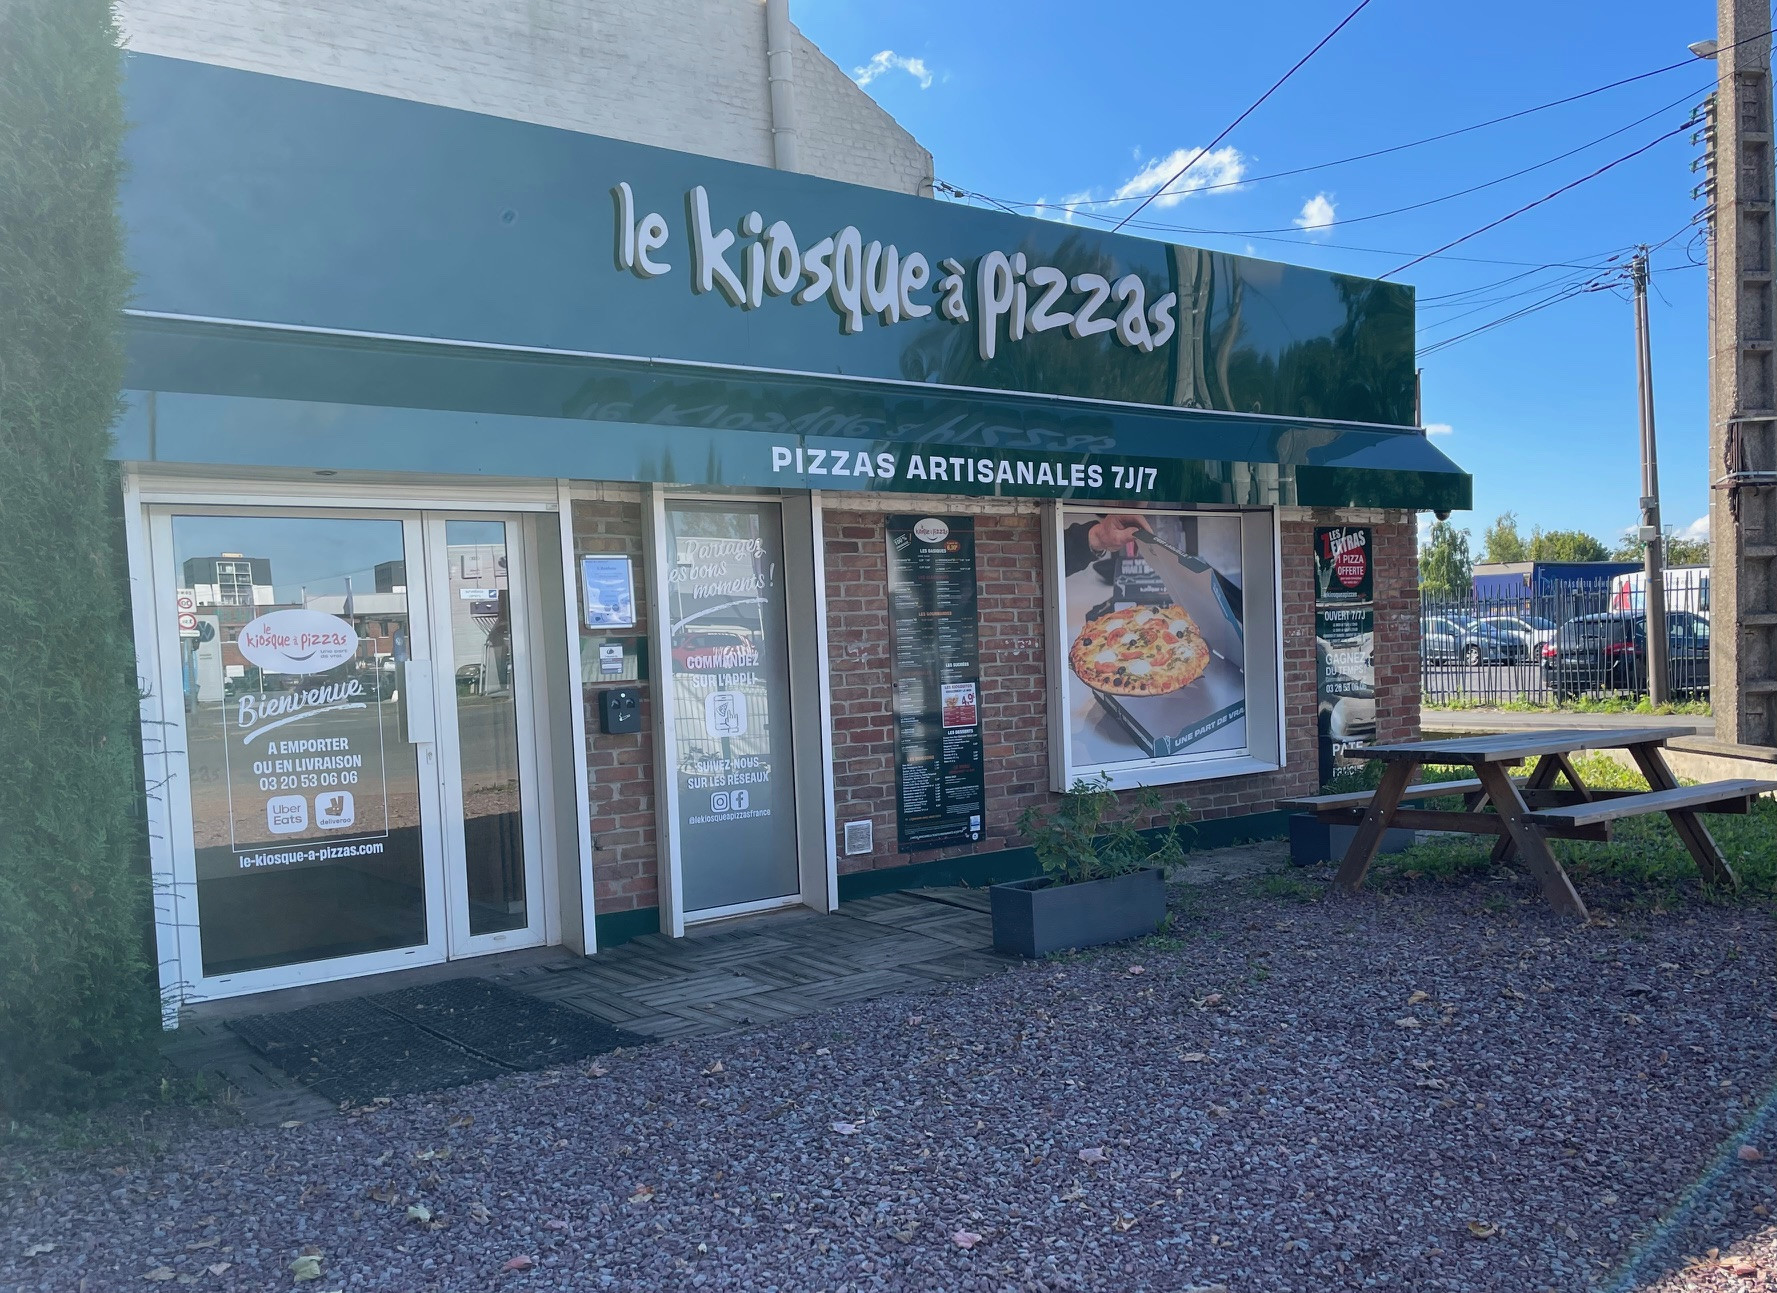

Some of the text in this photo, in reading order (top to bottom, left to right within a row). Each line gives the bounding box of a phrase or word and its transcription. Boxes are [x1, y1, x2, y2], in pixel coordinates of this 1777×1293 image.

[614, 181, 1177, 361] le kiosque à pizzas
[771, 446, 1159, 493] PIZZAS ARTISANALES 7J/7
[1329, 529, 1341, 541] LES
[1330, 530, 1366, 557] EXTRAS
[685, 538, 767, 561] Partagez
[1343, 554, 1364, 564] PIZZA
[669, 560, 727, 583] es bons
[1337, 566, 1364, 576] OFFERTE
[693, 573, 765, 600] moments
[1324, 609, 1366, 621] OUVERT 7/7J
[263, 622, 272, 635] le
[246, 632, 291, 649] kiosque
[301, 632, 347, 651] pizzas
[686, 652, 759, 669] COMMANDEZ
[1325, 652, 1366, 665] GAGNEZ
[1325, 664, 1364, 676] DU TEMPS
[693, 674, 717, 688] SUR
[1325, 684, 1334, 694] 03
[1343, 682, 1351, 692] 53
[238, 679, 364, 728] Bienvenue
[1174, 732, 1194, 747] UNE
[1194, 720, 1216, 738] PART
[1216, 713, 1228, 726] DE
[268, 737, 349, 755] A EMPORTER
[253, 754, 362, 775] OU EN LIVRAISON
[696, 756, 760, 773] SUIVEZ-NOUS
[259, 770, 358, 791] 03 20 53 06 06
[688, 770, 769, 790] SUR LES RÉSEAUX
[272, 803, 302, 815] Uber
[273, 814, 303, 826] Eats
[319, 817, 352, 826] deliveroo
[239, 842, 384, 869] le-kiosque-a-pizzas.com
